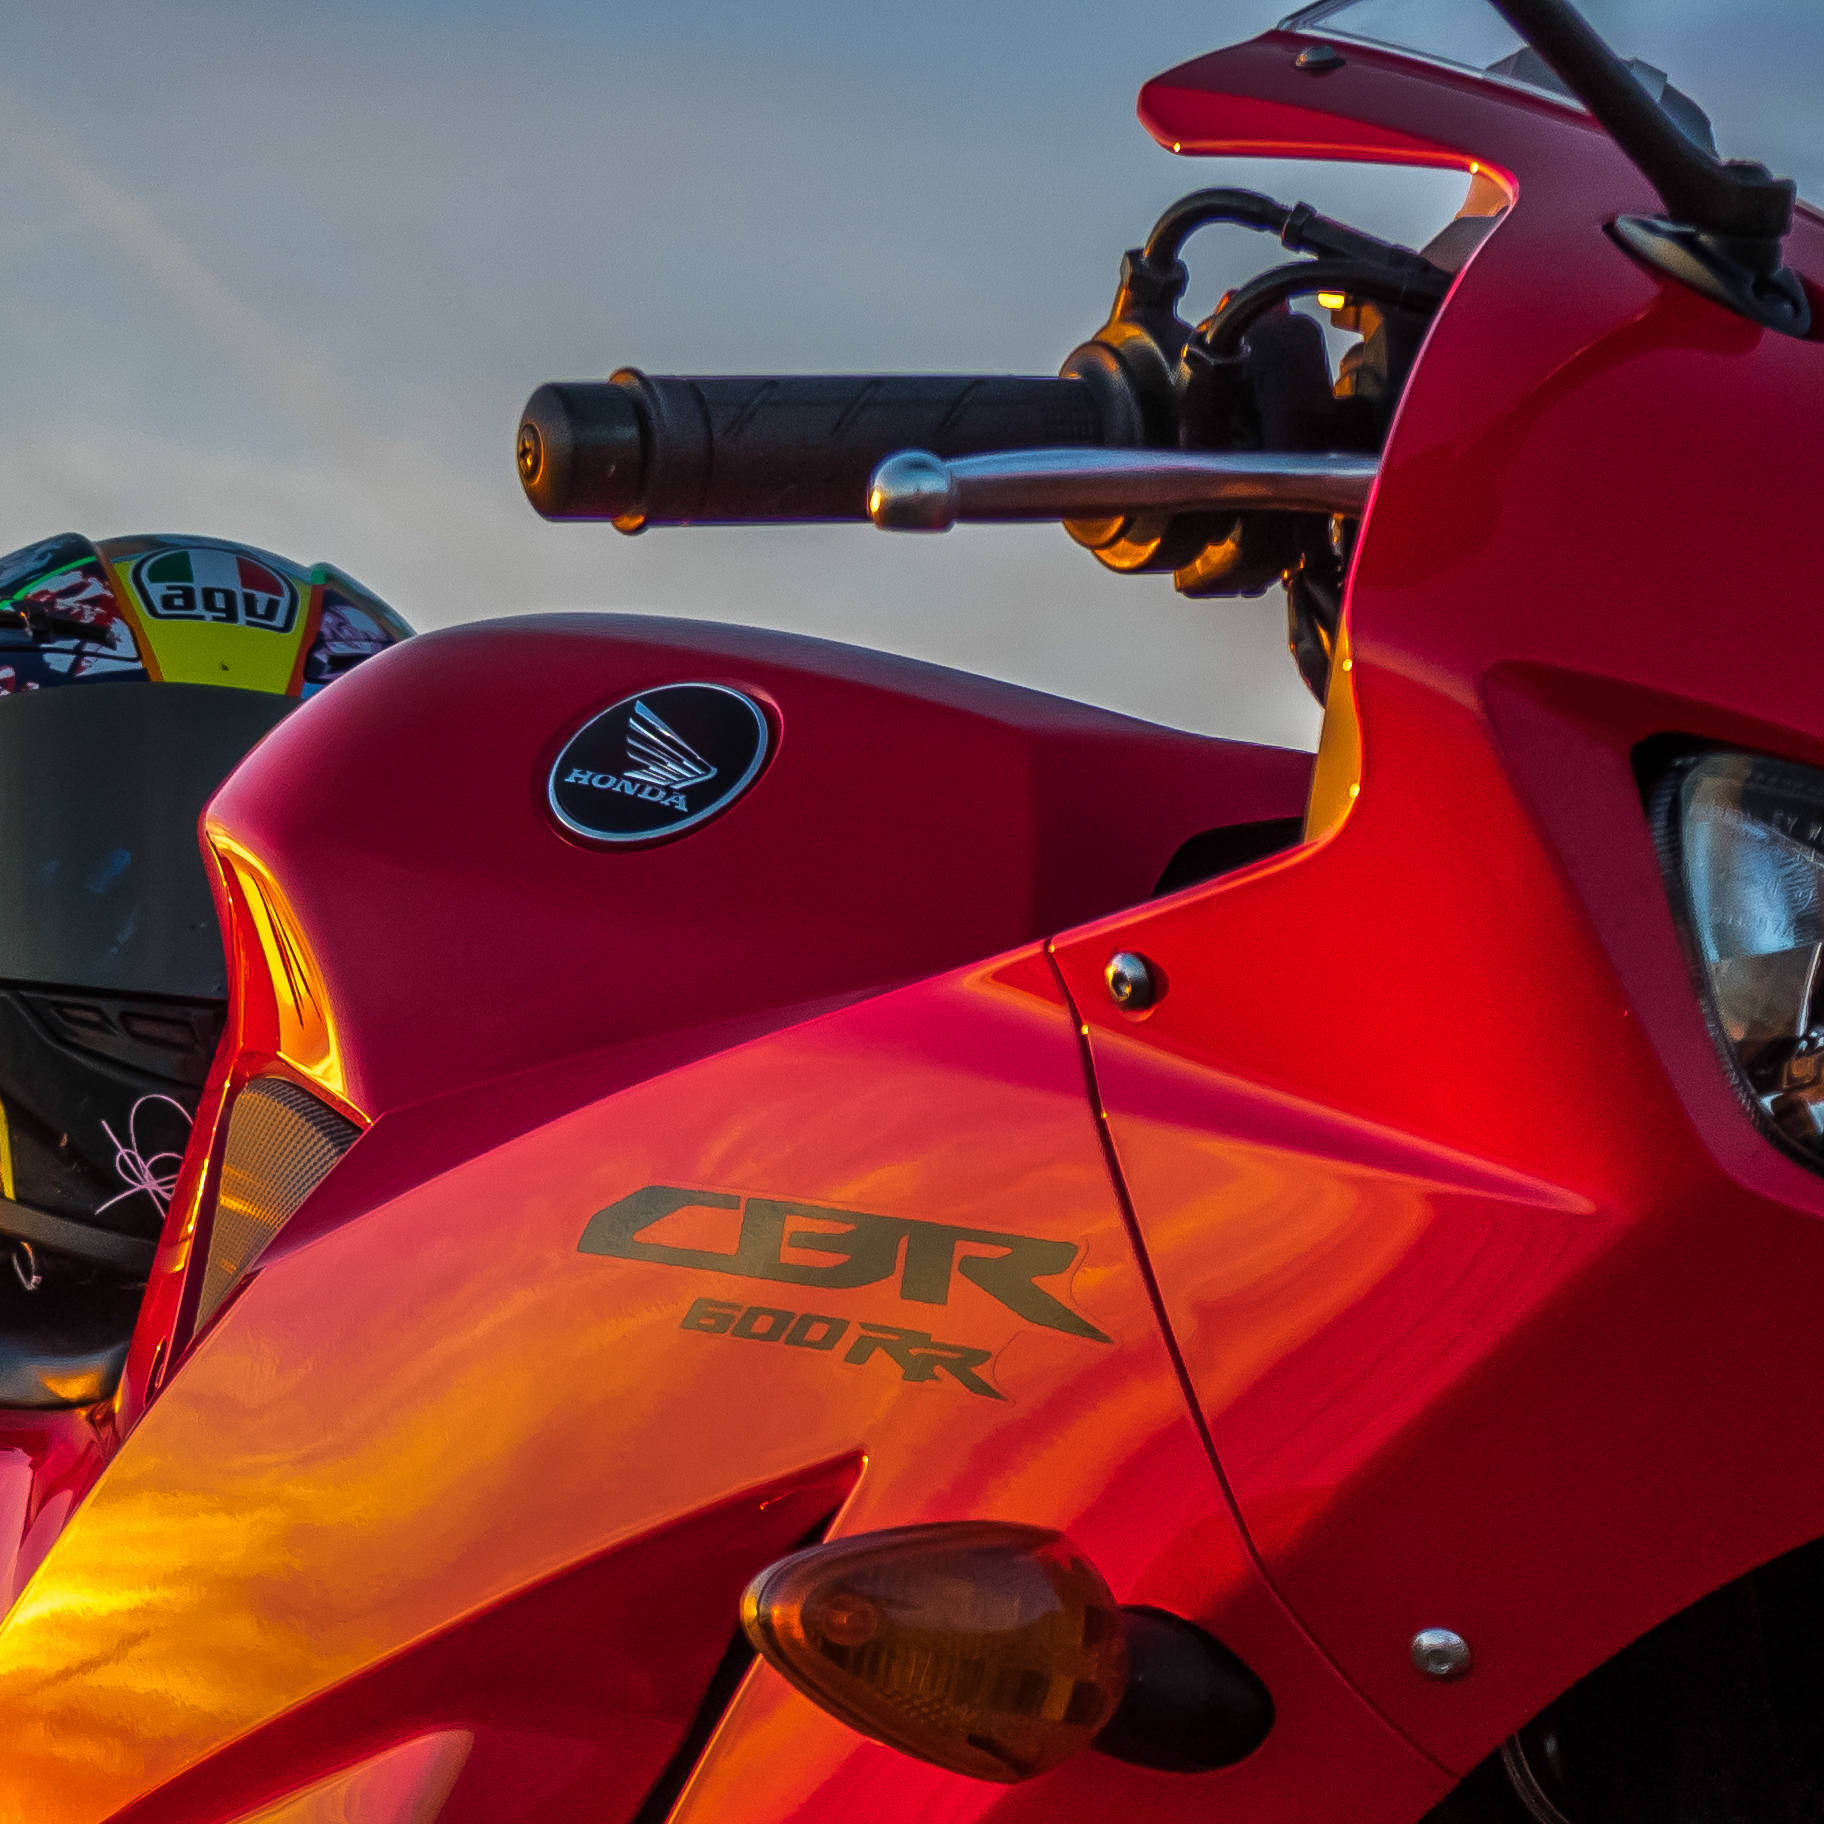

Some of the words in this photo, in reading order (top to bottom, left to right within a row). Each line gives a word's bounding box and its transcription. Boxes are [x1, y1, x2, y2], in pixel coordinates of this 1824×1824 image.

[161, 585, 281, 634] agv
[564, 768, 689, 812] HONDA
[577, 1186, 1114, 1344] CBR
